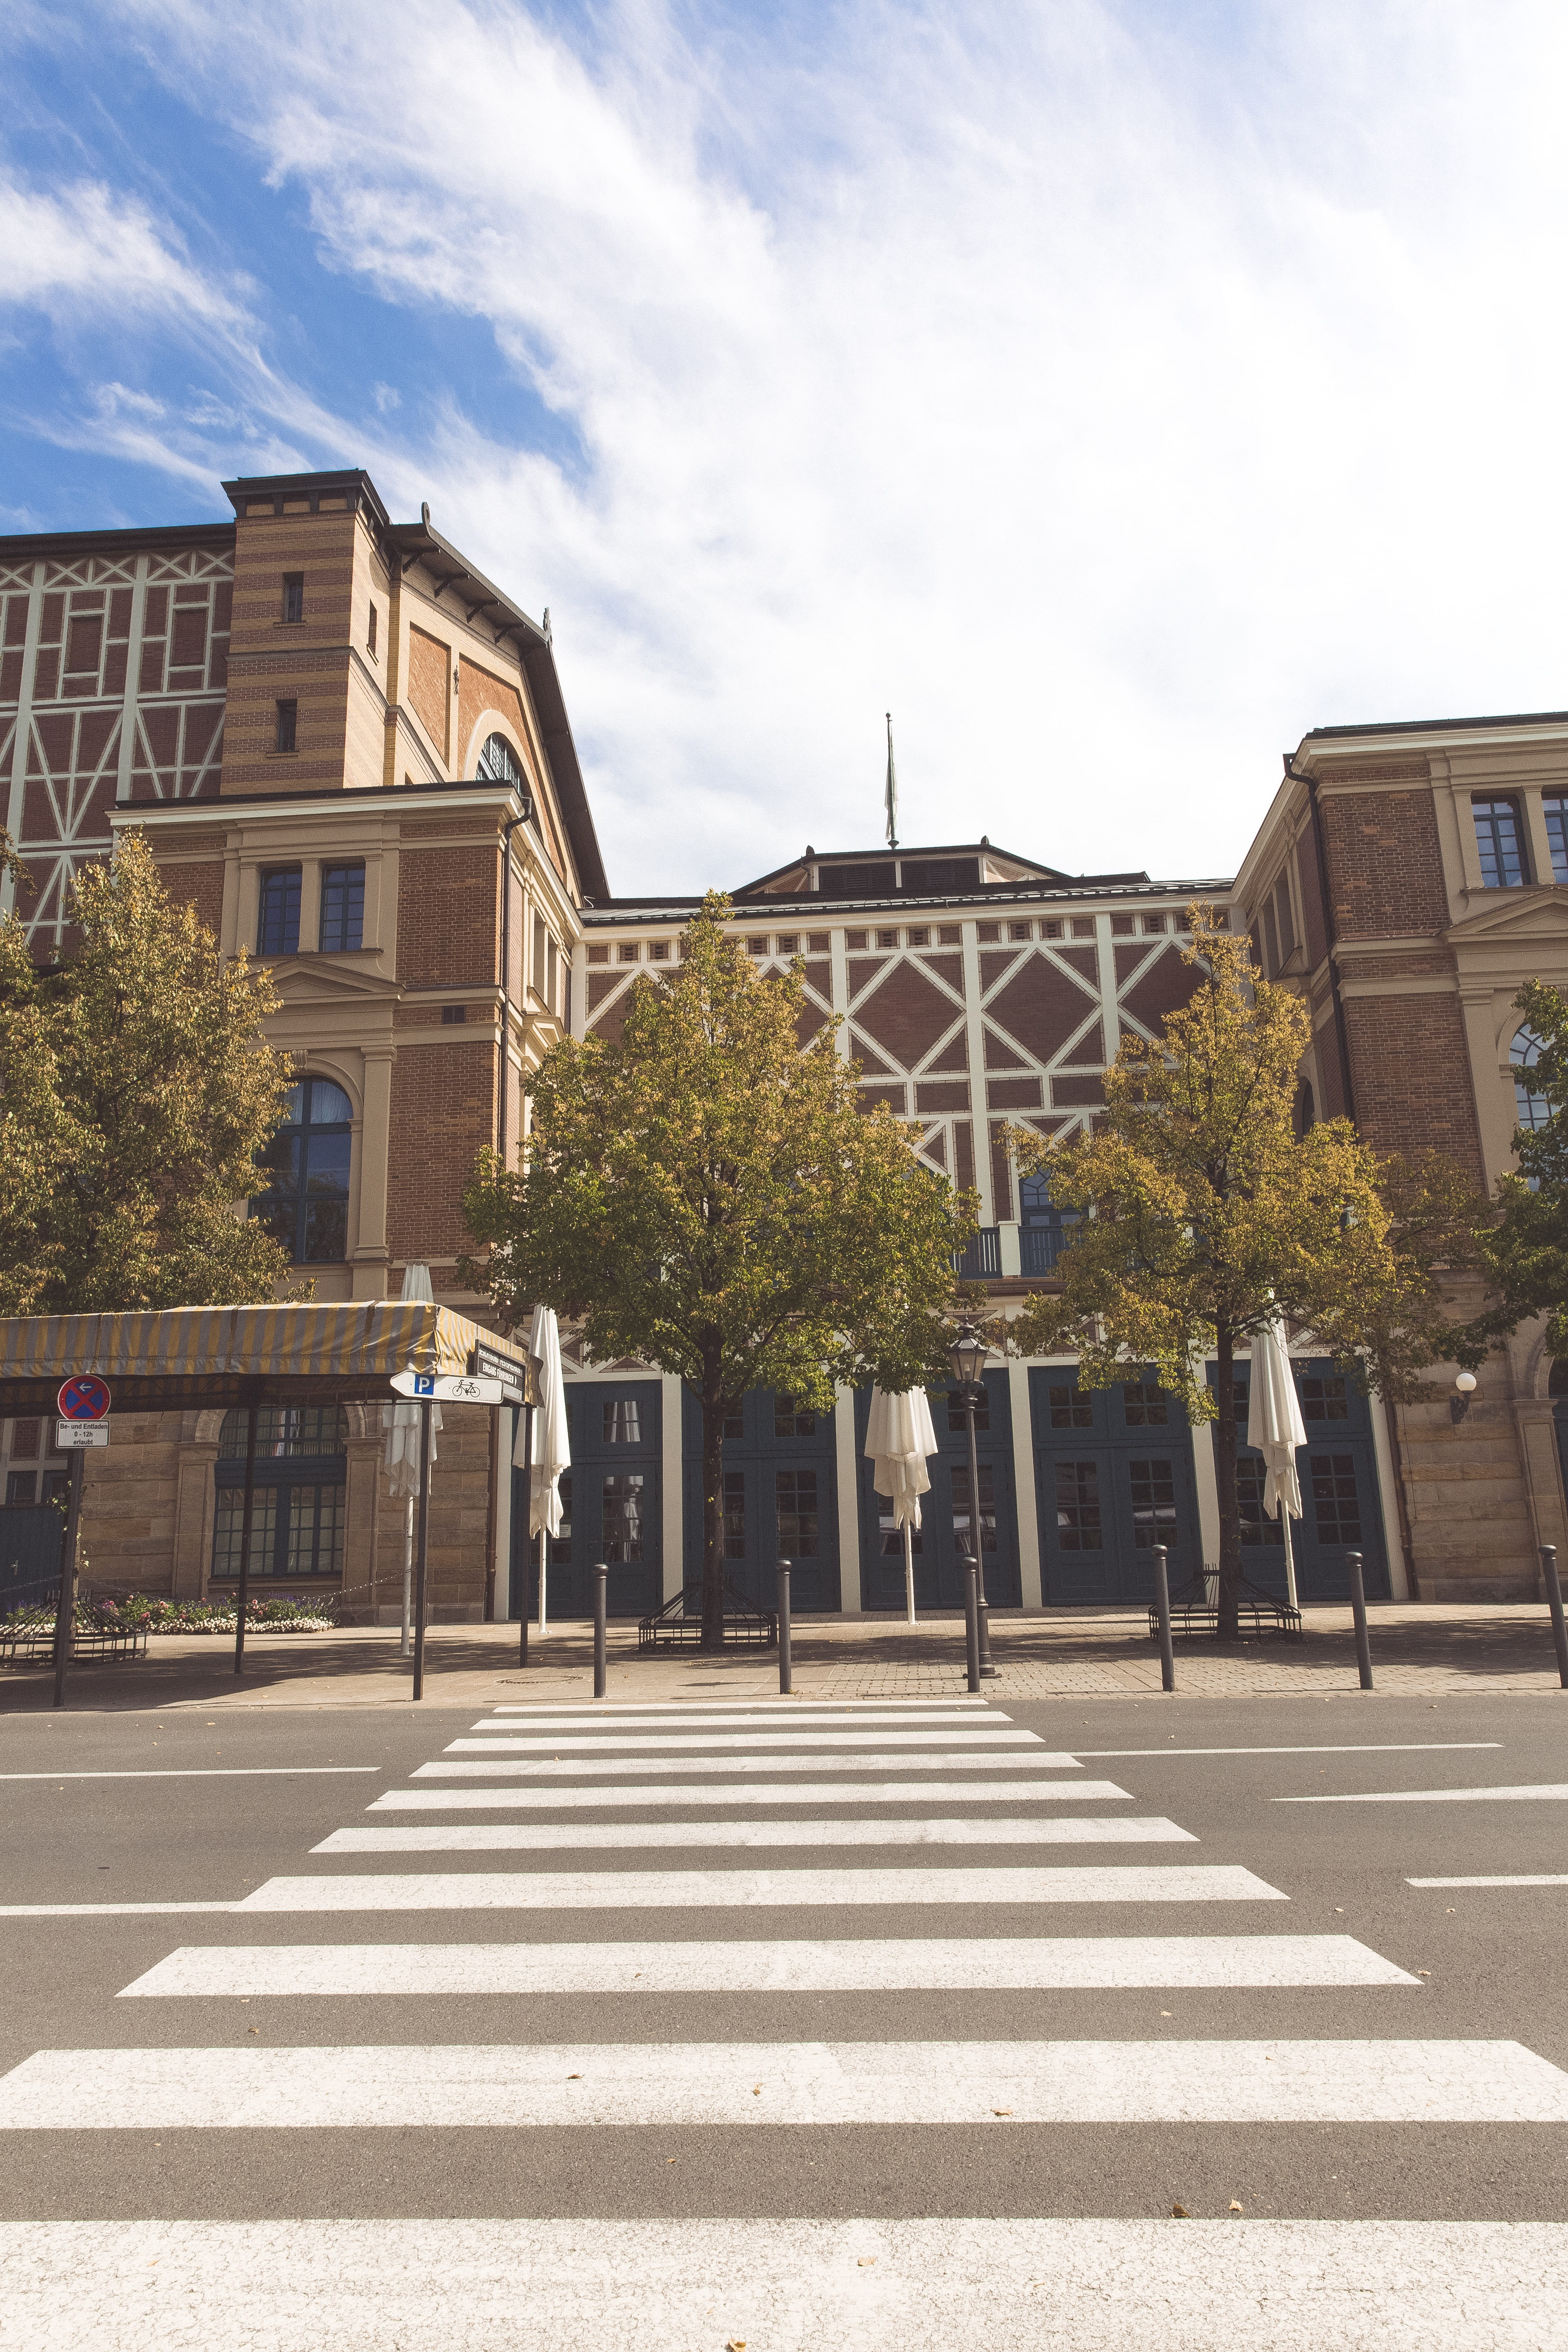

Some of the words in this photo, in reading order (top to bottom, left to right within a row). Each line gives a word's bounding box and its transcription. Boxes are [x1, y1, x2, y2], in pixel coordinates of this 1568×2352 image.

[483, 1362, 497, 1376] EINGANG
[497, 1368, 514, 1384] FÜHRUNGEN
[419, 1377, 430, 1392] P
